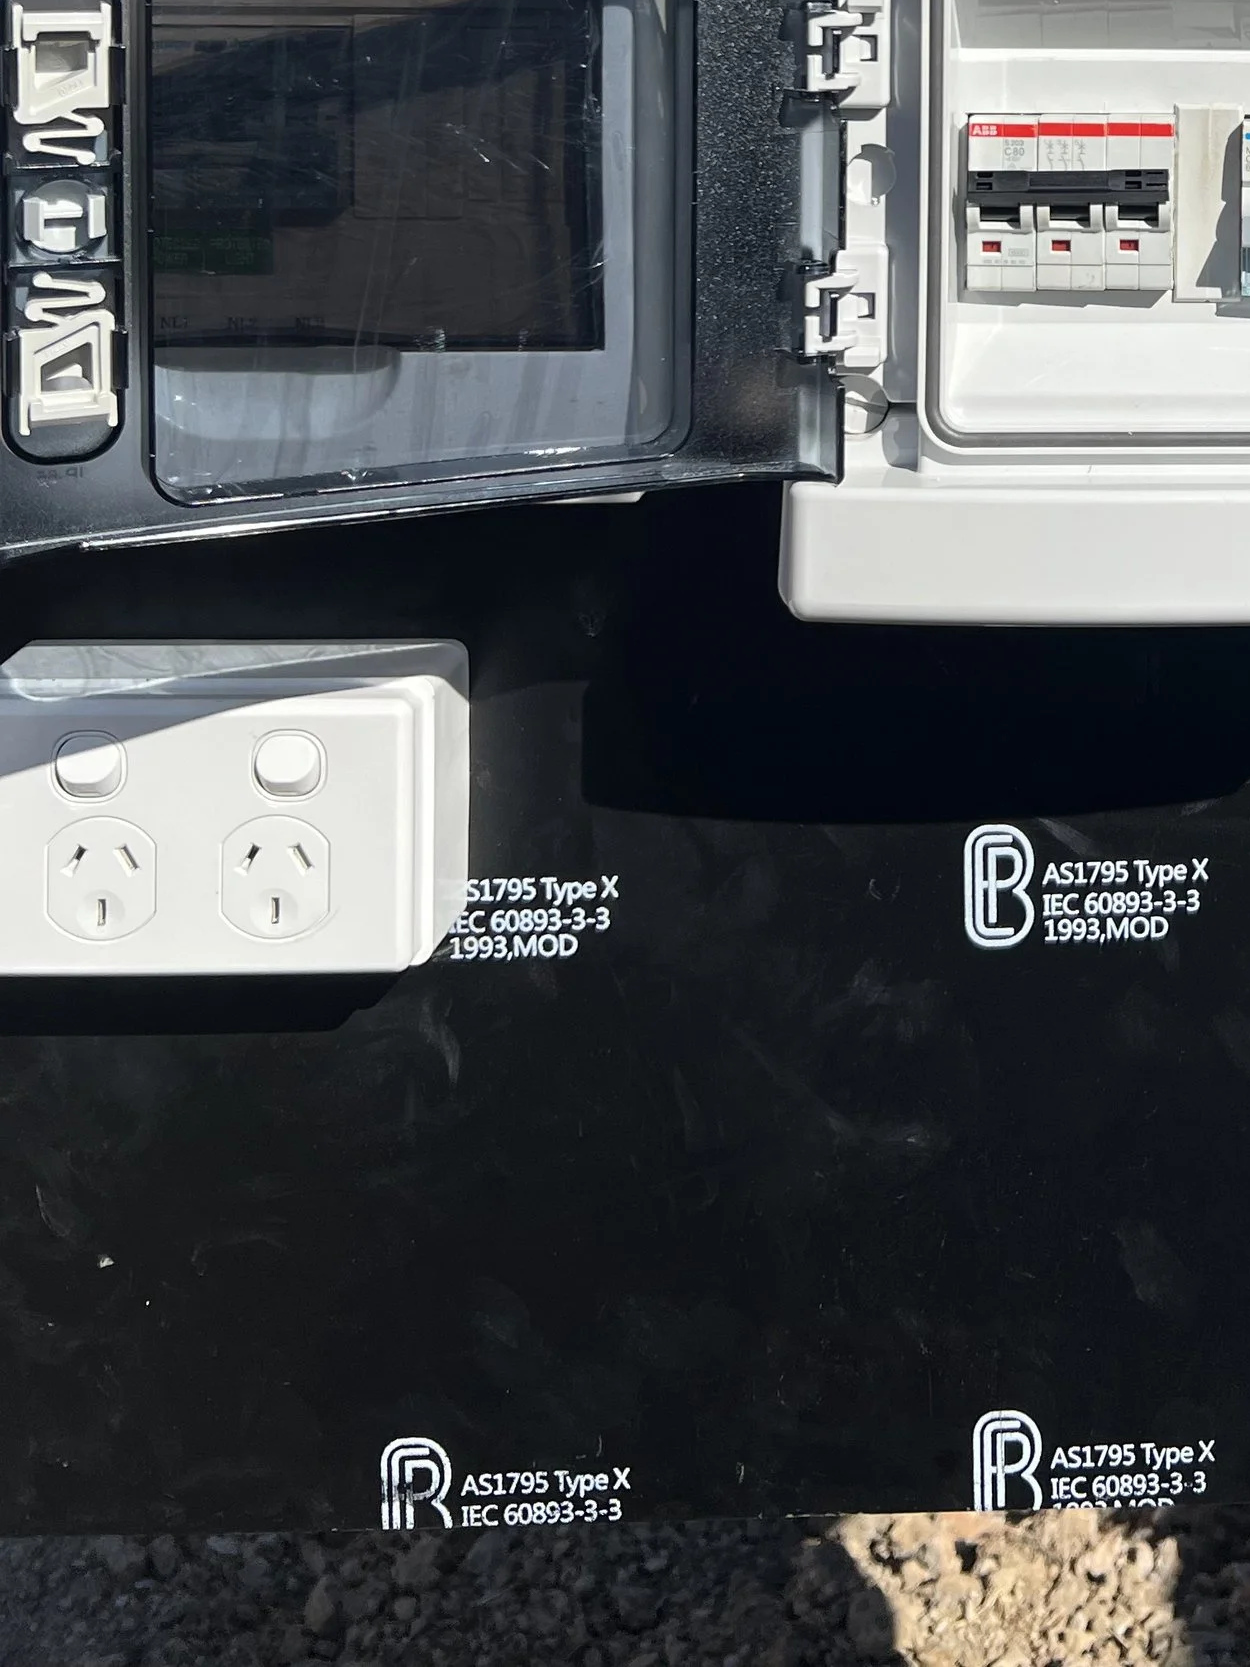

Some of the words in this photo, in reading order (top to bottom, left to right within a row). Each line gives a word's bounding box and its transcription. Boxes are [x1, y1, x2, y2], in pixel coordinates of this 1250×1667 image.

[972, 125, 998, 136] ABB
[1042, 860, 1130, 886] AS1795
[1133, 859, 1188, 888] Type
[1191, 857, 1210, 881] X
[465, 877, 537, 902] S1795
[540, 876, 598, 906] Type
[600, 875, 619, 899] X
[1042, 893, 1080, 917] IEC
[1084, 889, 1201, 916] 60893-3-3
[489, 907, 611, 933] 60893-3-3
[1044, 916, 1169, 945] 1993,MOD
[449, 934, 579, 961] 1993,MOD
[1050, 1444, 1136, 1470] AS1795
[1140, 1442, 1194, 1470] Type
[1198, 1440, 1216, 1463] X
[461, 1471, 549, 1496] AS1795
[554, 1470, 609, 1498] Type
[612, 1467, 631, 1490] X
[1050, 1476, 1087, 1500] IEC
[1092, 1471, 1207, 1498] 60893-3-3
[461, 1504, 499, 1527] IEC
[503, 1498, 622, 1526] 60893-3-3
